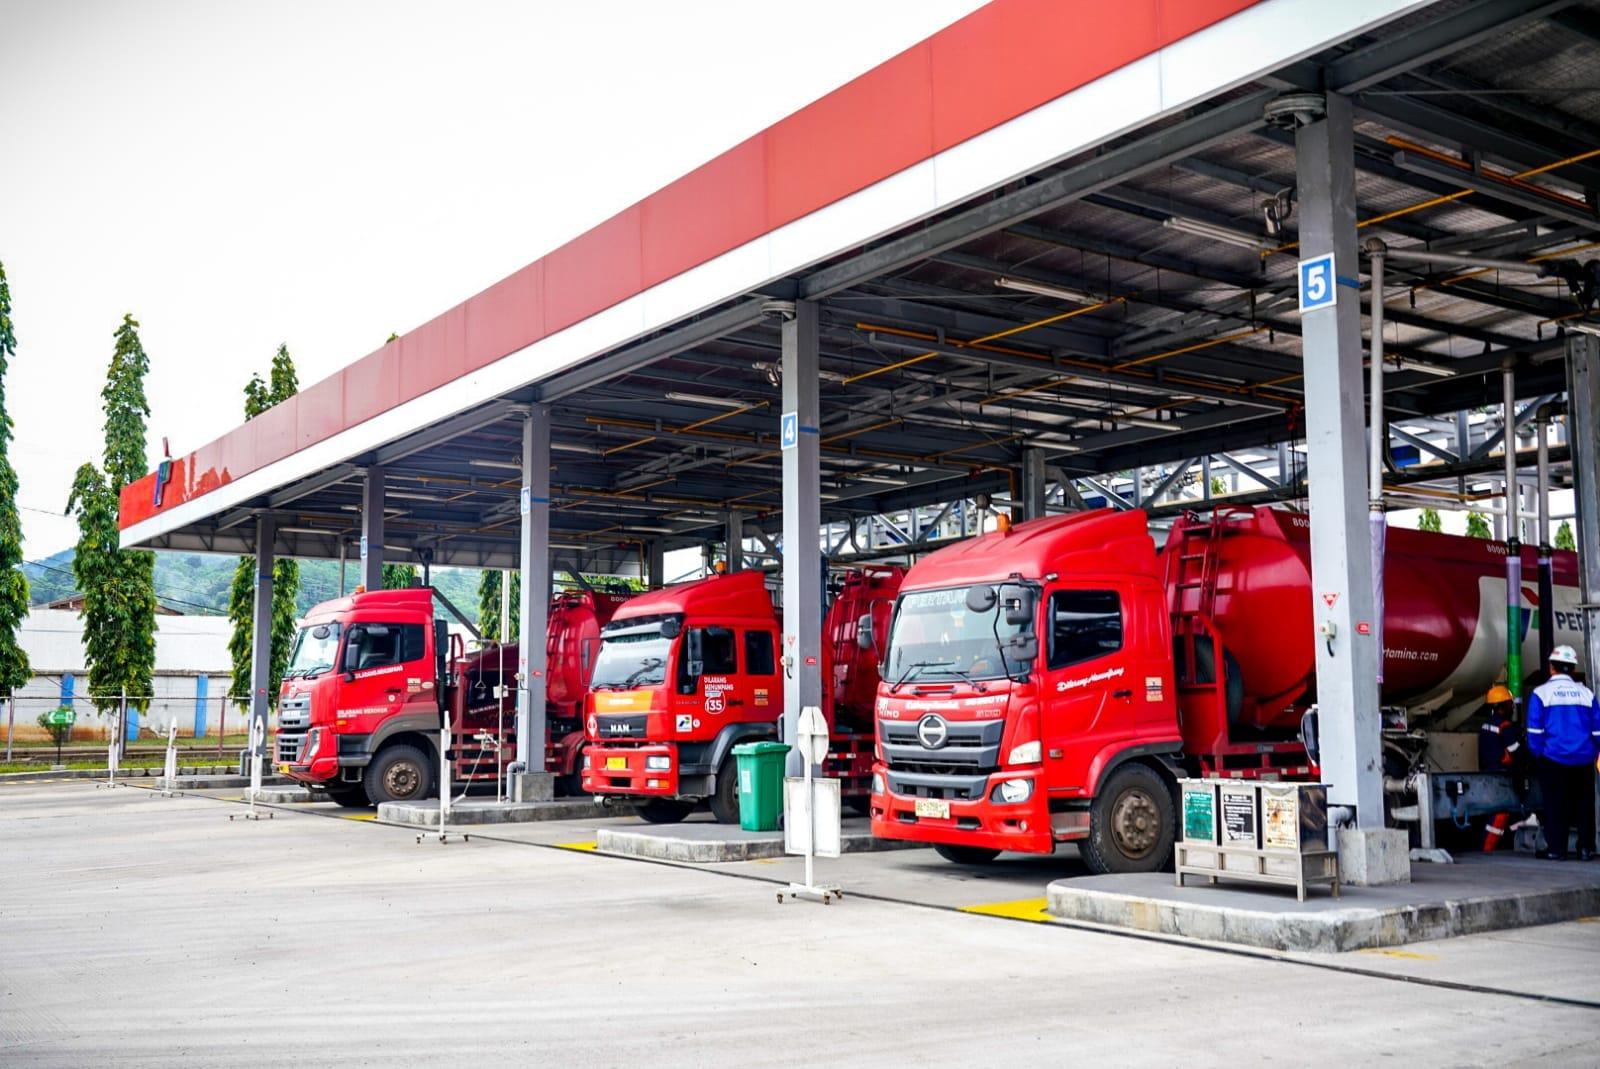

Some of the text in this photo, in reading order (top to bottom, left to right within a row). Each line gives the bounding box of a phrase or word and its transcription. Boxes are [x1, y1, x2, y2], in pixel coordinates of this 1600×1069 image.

[1307, 265, 1326, 301] 5
[784, 418, 794, 442] 4
[705, 699, 723, 711] 135
[610, 723, 630, 733] MAN
